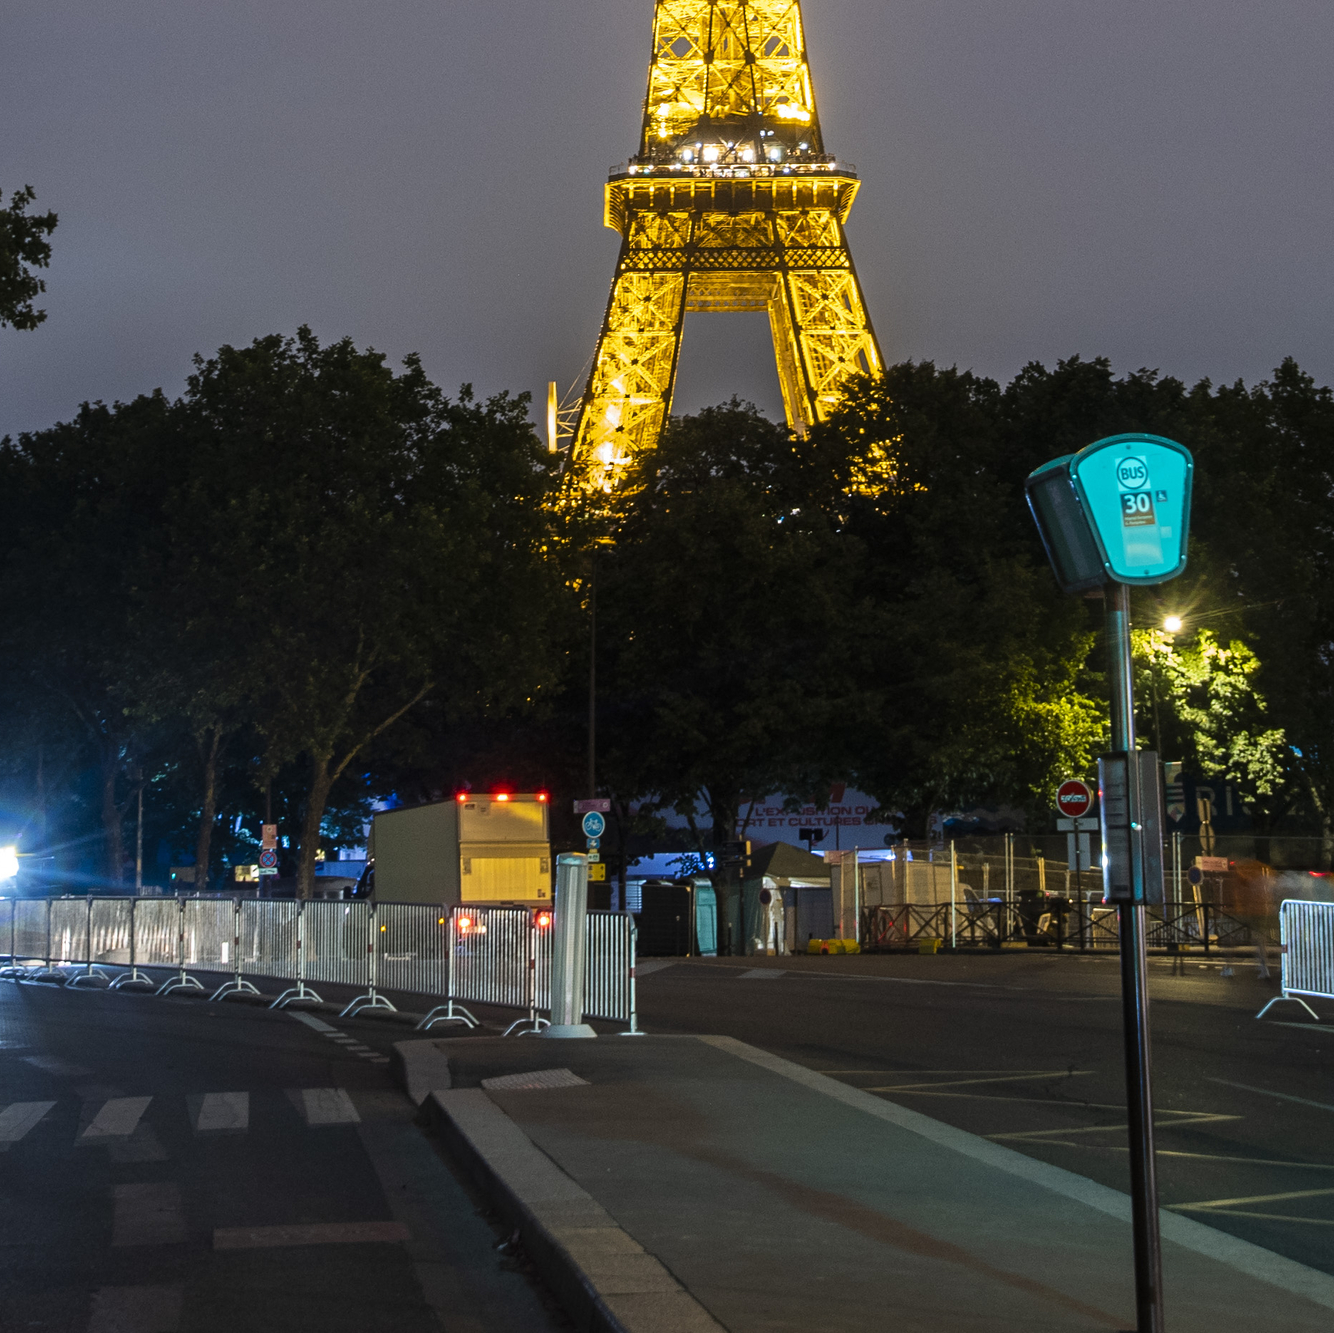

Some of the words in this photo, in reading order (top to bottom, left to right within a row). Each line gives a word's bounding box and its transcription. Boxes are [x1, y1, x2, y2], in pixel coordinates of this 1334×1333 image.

[1121, 466, 1144, 480] BUS
[1124, 493, 1150, 514] 30
[768, 817, 784, 827] ET
[788, 816, 861, 827] CULTURES
